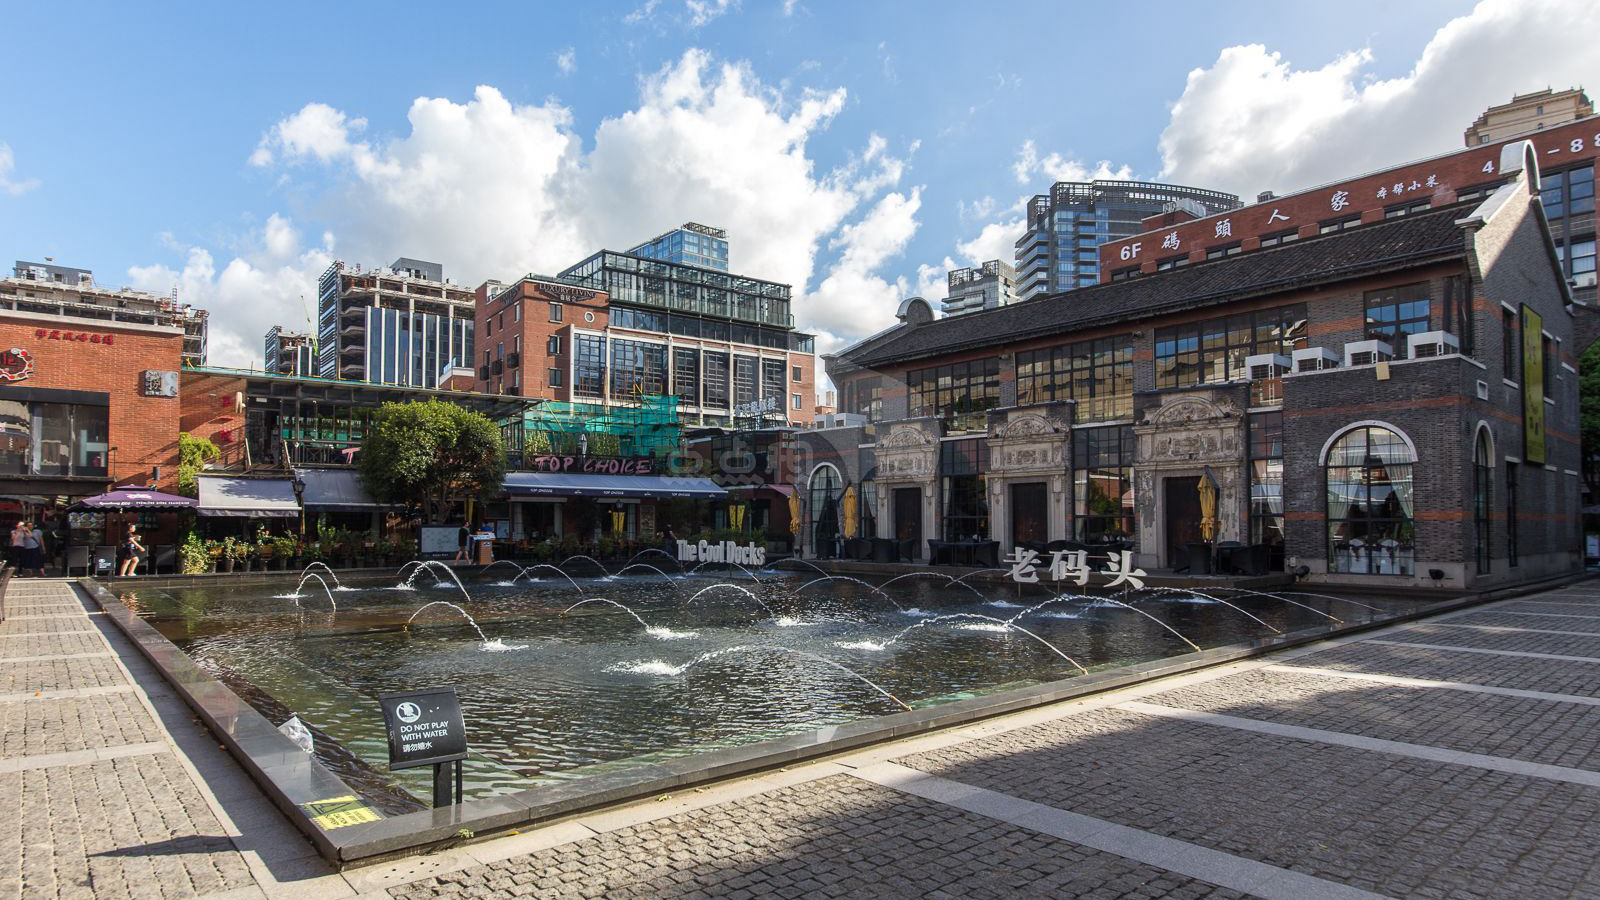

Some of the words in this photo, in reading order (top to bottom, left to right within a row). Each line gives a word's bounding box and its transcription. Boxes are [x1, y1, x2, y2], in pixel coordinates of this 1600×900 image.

[1120, 242, 1142, 261] 6F
[1161, 190, 1350, 251] 碼頭人家
[540, 284, 570, 294] LUXURY
[535, 456, 574, 472] TOP
[584, 459, 650, 474] CHOICE
[676, 540, 698, 562] The
[698, 539, 725, 563] Cool
[727, 540, 766, 565] Docks
[1003, 546, 1148, 589] 老码头
[400, 725, 412, 733] DO
[414, 723, 430, 731] NOT
[431, 720, 449, 729] PLAY
[401, 732, 422, 741] WITH
[422, 729, 448, 739] WATER
